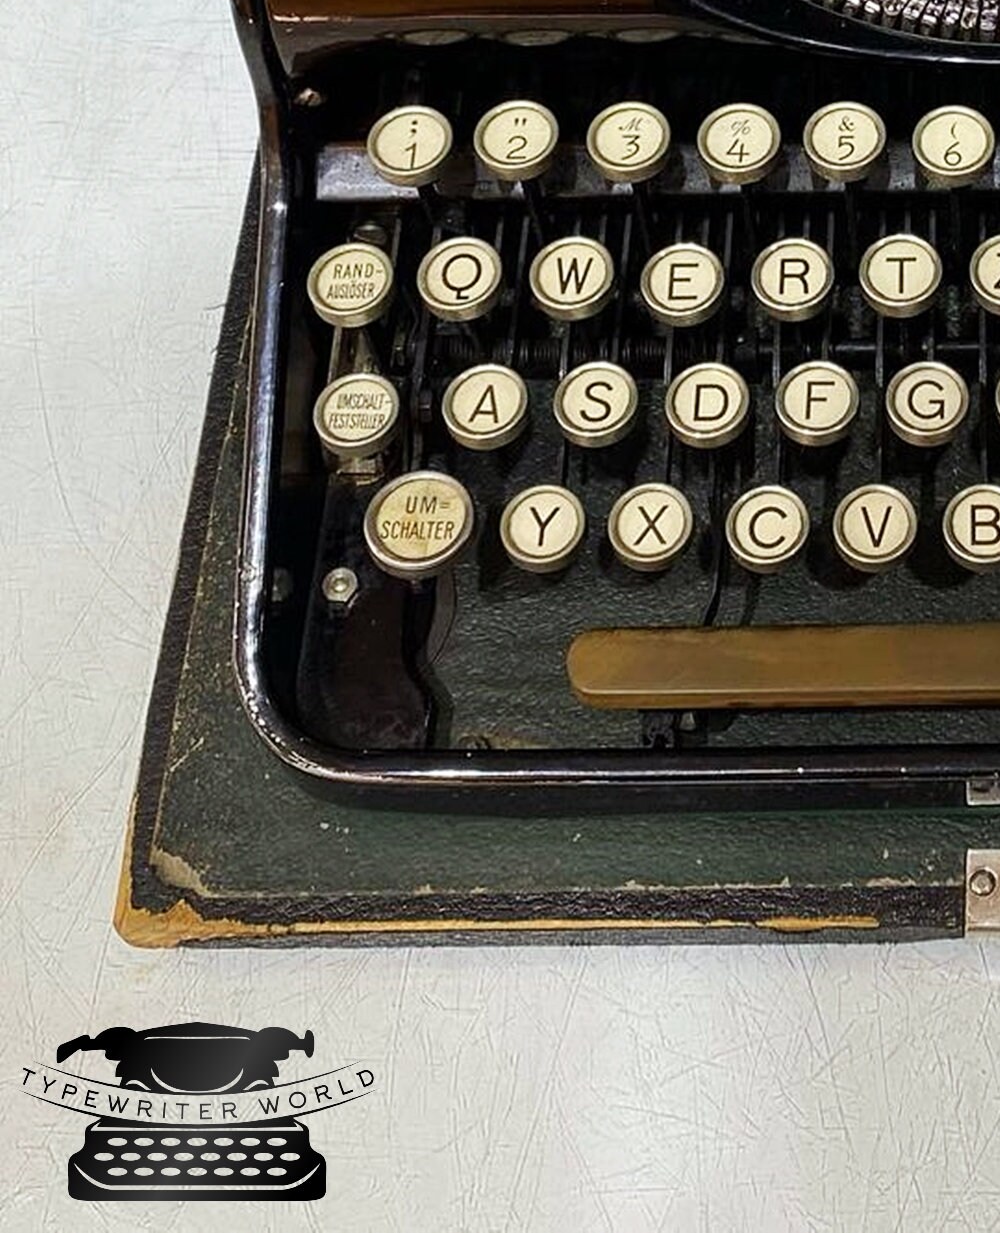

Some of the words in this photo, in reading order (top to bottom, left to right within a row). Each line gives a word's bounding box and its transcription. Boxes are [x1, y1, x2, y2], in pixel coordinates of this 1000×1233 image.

[838, 116, 854, 130] &
[404, 142, 418, 169] 1
[506, 136, 527, 160] 2
[621, 135, 640, 160] 3
[726, 139, 750, 163] 4
[838, 136, 855, 160] 5
[943, 142, 962, 166] 6
[442, 254, 482, 299] Q
[556, 257, 593, 294] W
[668, 263, 699, 300] E
[778, 258, 809, 294] R
[886, 257, 917, 294] T
[468, 384, 499, 424] A
[579, 381, 614, 422] S
[692, 384, 729, 422] D
[804, 380, 836, 420] F
[907, 380, 946, 420] G
[380, 520, 455, 540] SCHALTER
[529, 506, 561, 547] Y
[632, 504, 669, 546] X
[749, 506, 788, 549] C
[860, 506, 892, 548] V
